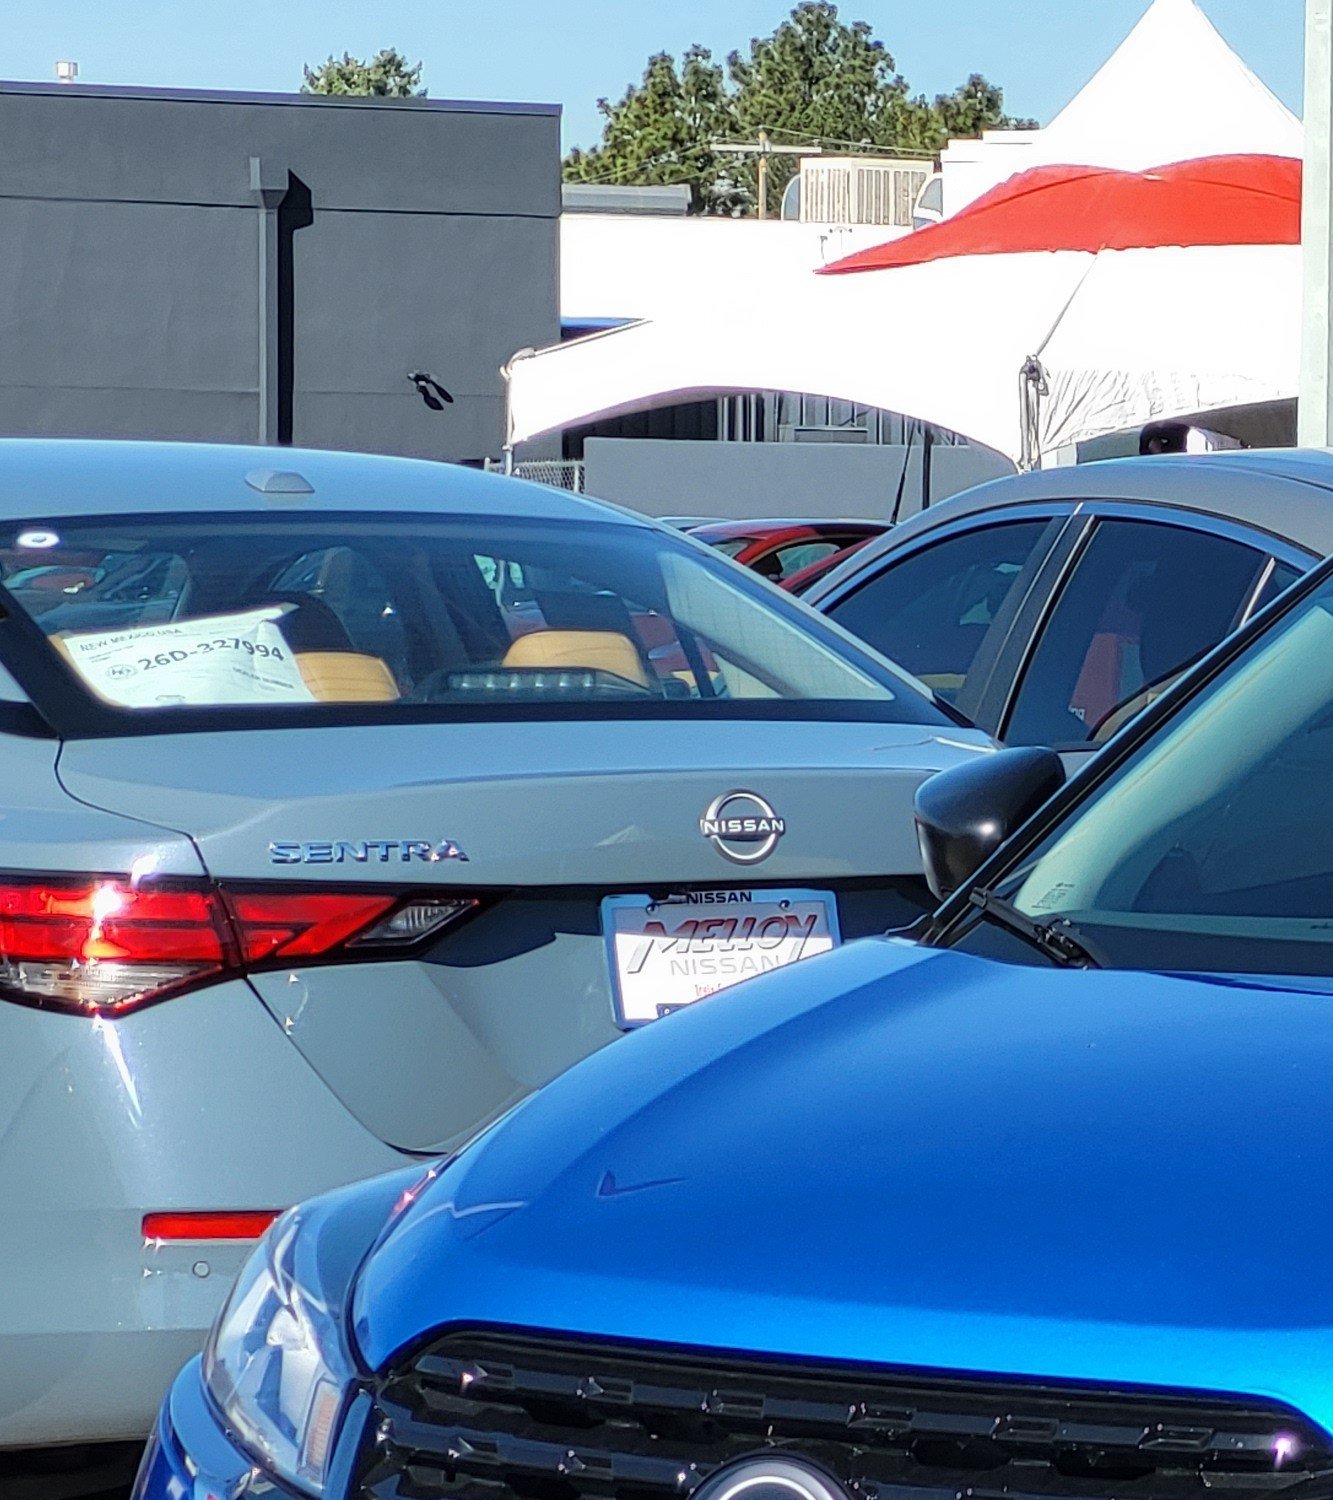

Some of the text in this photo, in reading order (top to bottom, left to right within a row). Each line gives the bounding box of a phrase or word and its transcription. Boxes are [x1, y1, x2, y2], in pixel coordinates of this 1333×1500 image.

[137, 636, 285, 672] 26D-327994
[702, 817, 785, 835] NISSAN
[268, 838, 471, 865] SENTRA
[686, 891, 752, 904] NISSAN
[626, 914, 818, 975] MELLOY
[670, 954, 782, 976] NISSAN
